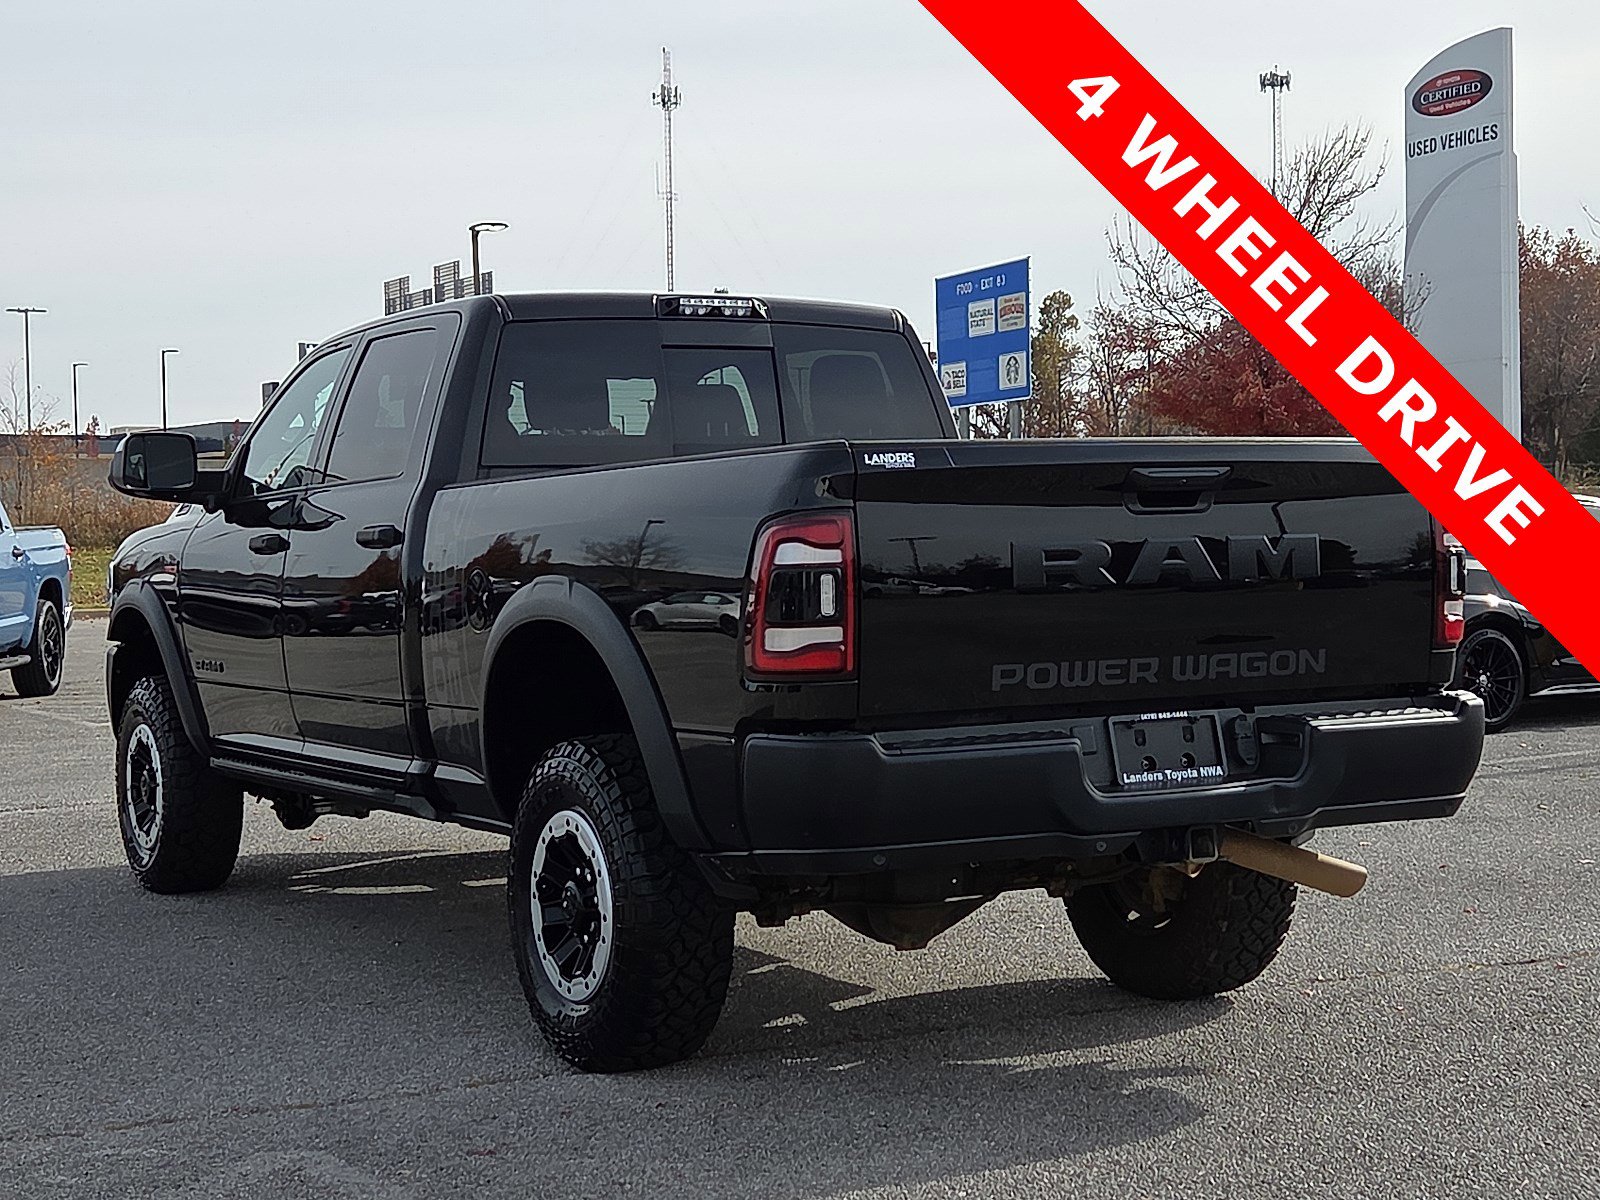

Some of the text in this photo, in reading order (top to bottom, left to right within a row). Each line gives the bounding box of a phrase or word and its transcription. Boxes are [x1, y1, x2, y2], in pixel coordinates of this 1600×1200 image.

[1420, 81, 1481, 105] CERTIFIED
[1408, 123, 1499, 159] USED VEHICLES
[956, 281, 974, 296] FOOD
[980, 276, 994, 291] EXIT
[969, 307, 994, 319] NATURAL
[970, 317, 987, 329] STATE
[951, 369, 965, 380] TACO
[952, 379, 966, 390] BELL
[863, 452, 916, 466] LANDERS
[1010, 533, 1322, 590] RAM
[991, 648, 1327, 692] POWER WAGON
[1123, 765, 1224, 784] Landers Toyota NWA
